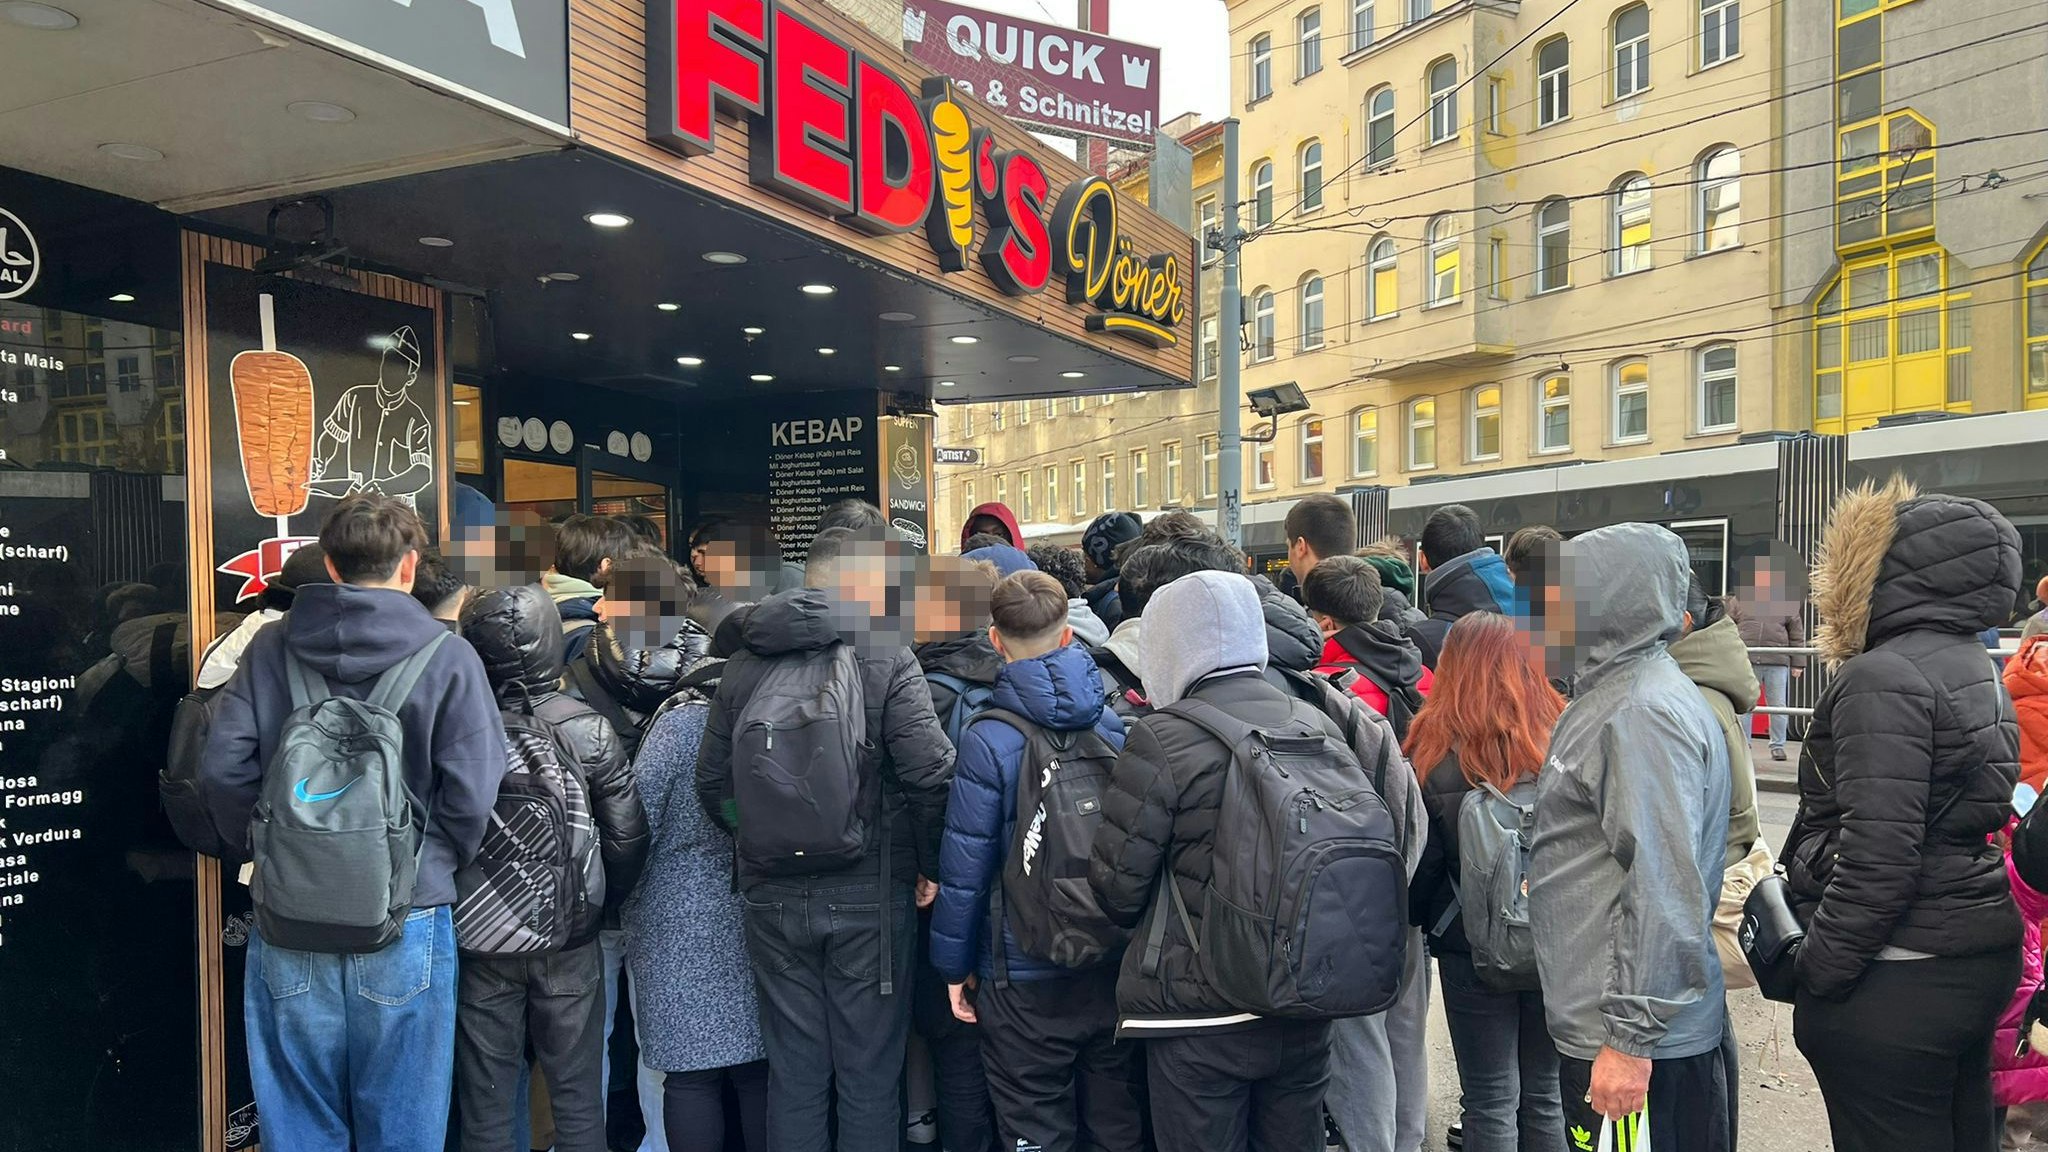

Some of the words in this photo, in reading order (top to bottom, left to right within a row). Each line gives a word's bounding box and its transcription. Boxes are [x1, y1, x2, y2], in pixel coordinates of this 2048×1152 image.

[946, 14, 1105, 85] QUICK
[985, 79, 1008, 107] &
[1019, 85, 1151, 135] Schnitzel
[1062, 177, 1185, 327] Döner
[0, 320, 32, 334] ard
[24, 352, 64, 371] Mais
[771, 416, 863, 447] KEBAP
[794, 452, 815, 460] Kebap
[780, 461, 820, 470] Joghurtsauce
[795, 470, 815, 478] Kebap
[847, 466, 864, 474] Salat
[780, 479, 821, 488] Joghurtsauce
[796, 487, 816, 495] Kebap
[781, 497, 822, 505] Joghurtsauce
[889, 498, 926, 512] SANDWICH
[796, 505, 816, 513] Kebap
[796, 523, 817, 531] Kebap
[1, 675, 75, 694] Stagioni
[0, 694, 62, 712] scharf)
[0, 775, 37, 790] iosa
[5, 790, 83, 809] Formagg
[0, 870, 39, 888] ciale
